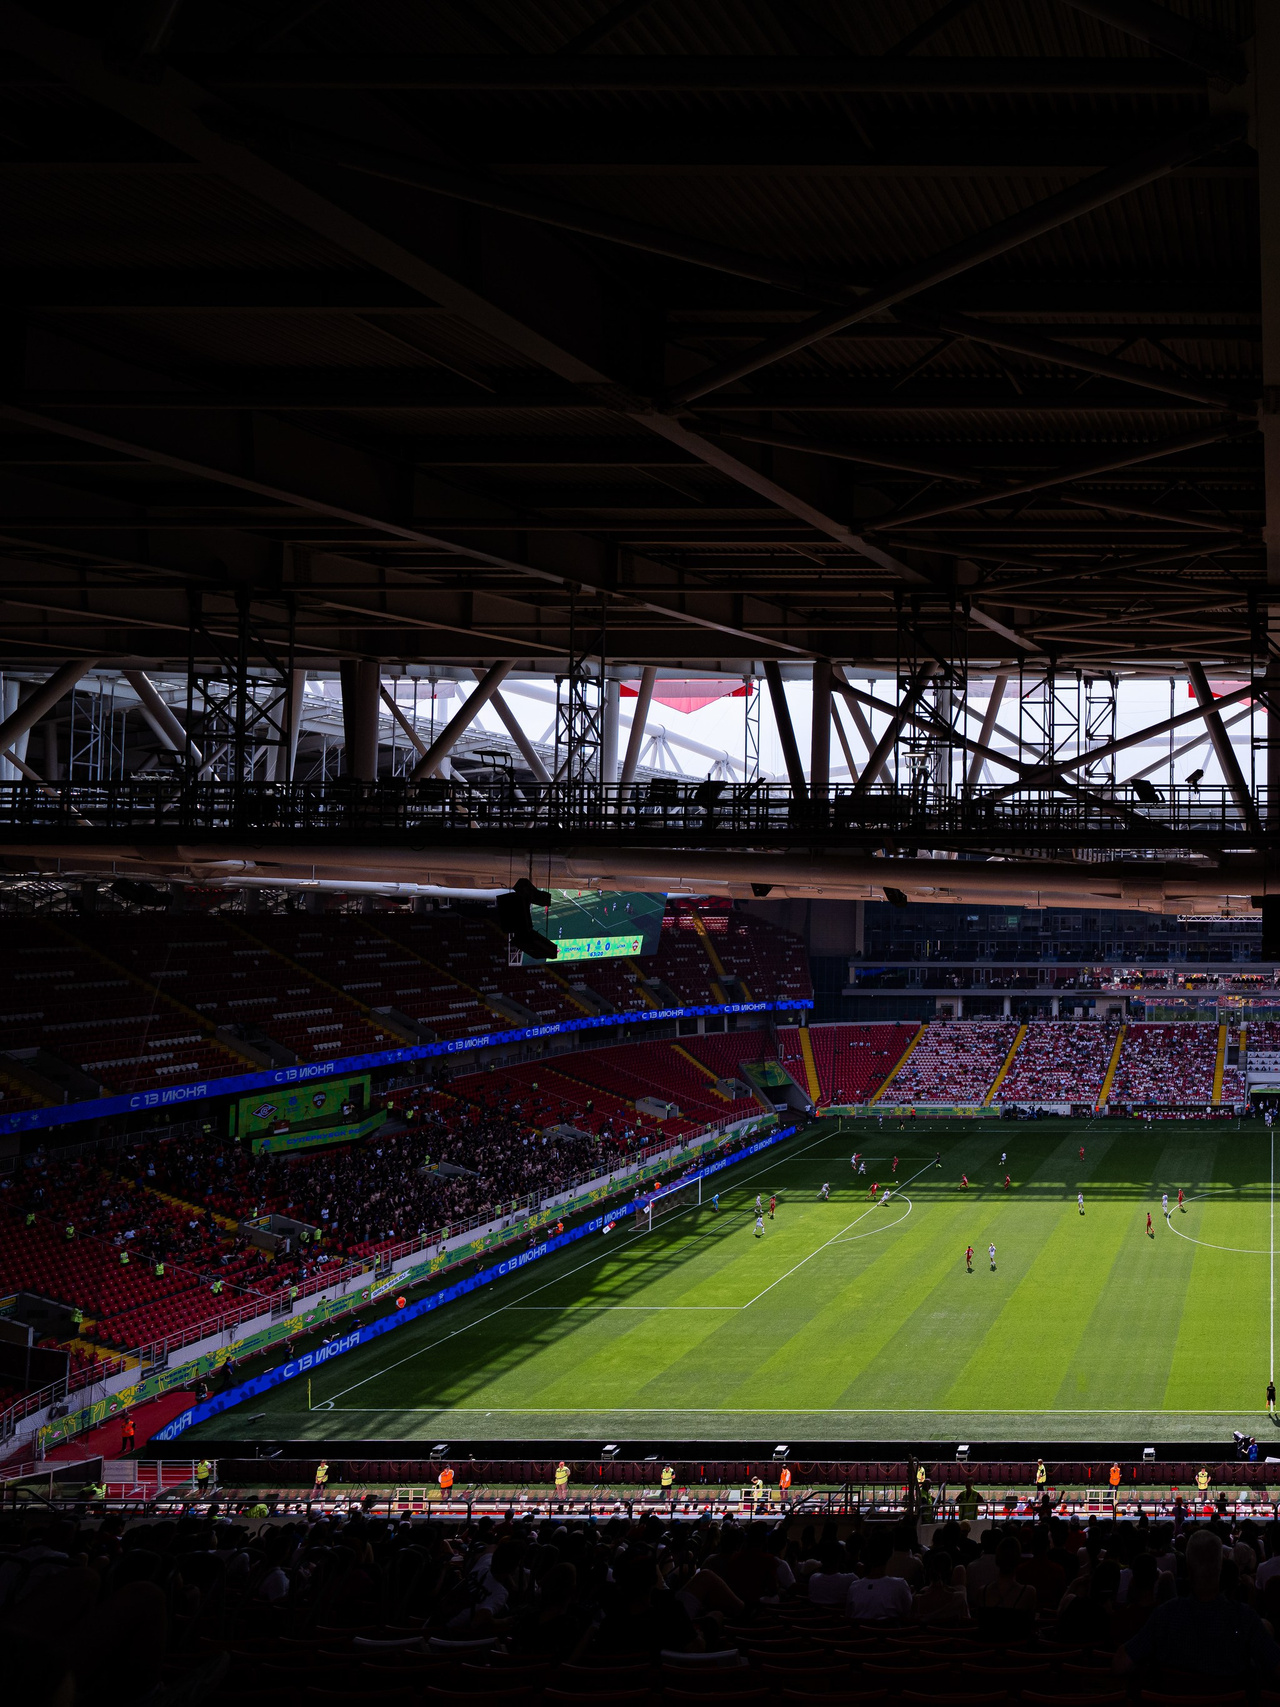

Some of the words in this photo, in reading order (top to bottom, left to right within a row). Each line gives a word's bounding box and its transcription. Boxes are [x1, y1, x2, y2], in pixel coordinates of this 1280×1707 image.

[586, 944, 590, 952] 1
[605, 942, 610, 951] 0
[642, 1012, 648, 1020] С
[649, 1011, 657, 1019] 13
[658, 1009, 684, 1018] ИЮНЯ
[741, 1003, 766, 1011] ИЮНЯ
[526, 1029, 532, 1037] С
[532, 1028, 540, 1036] 13
[540, 1024, 560, 1036] ИЮНЯ
[447, 1042, 454, 1051] С
[454, 1041, 464, 1050] 13
[464, 1036, 489, 1049] ИЮНЯ
[274, 1072, 284, 1082] С
[286, 1069, 298, 1080] 13
[299, 1063, 334, 1078] ИЮНЯ
[130, 1096, 140, 1108] С
[144, 1093, 158, 1105] 13
[161, 1084, 207, 1102] ИЮНЯ
[604, 1206, 627, 1224] ИЮНЯ
[498, 1263, 506, 1274] С
[508, 1259, 518, 1271] 13
[519, 1244, 547, 1266] ИЮНЯ
[283, 1364, 294, 1378] С
[298, 1356, 312, 1370] 13
[316, 1332, 360, 1363] ИЮНЯ
